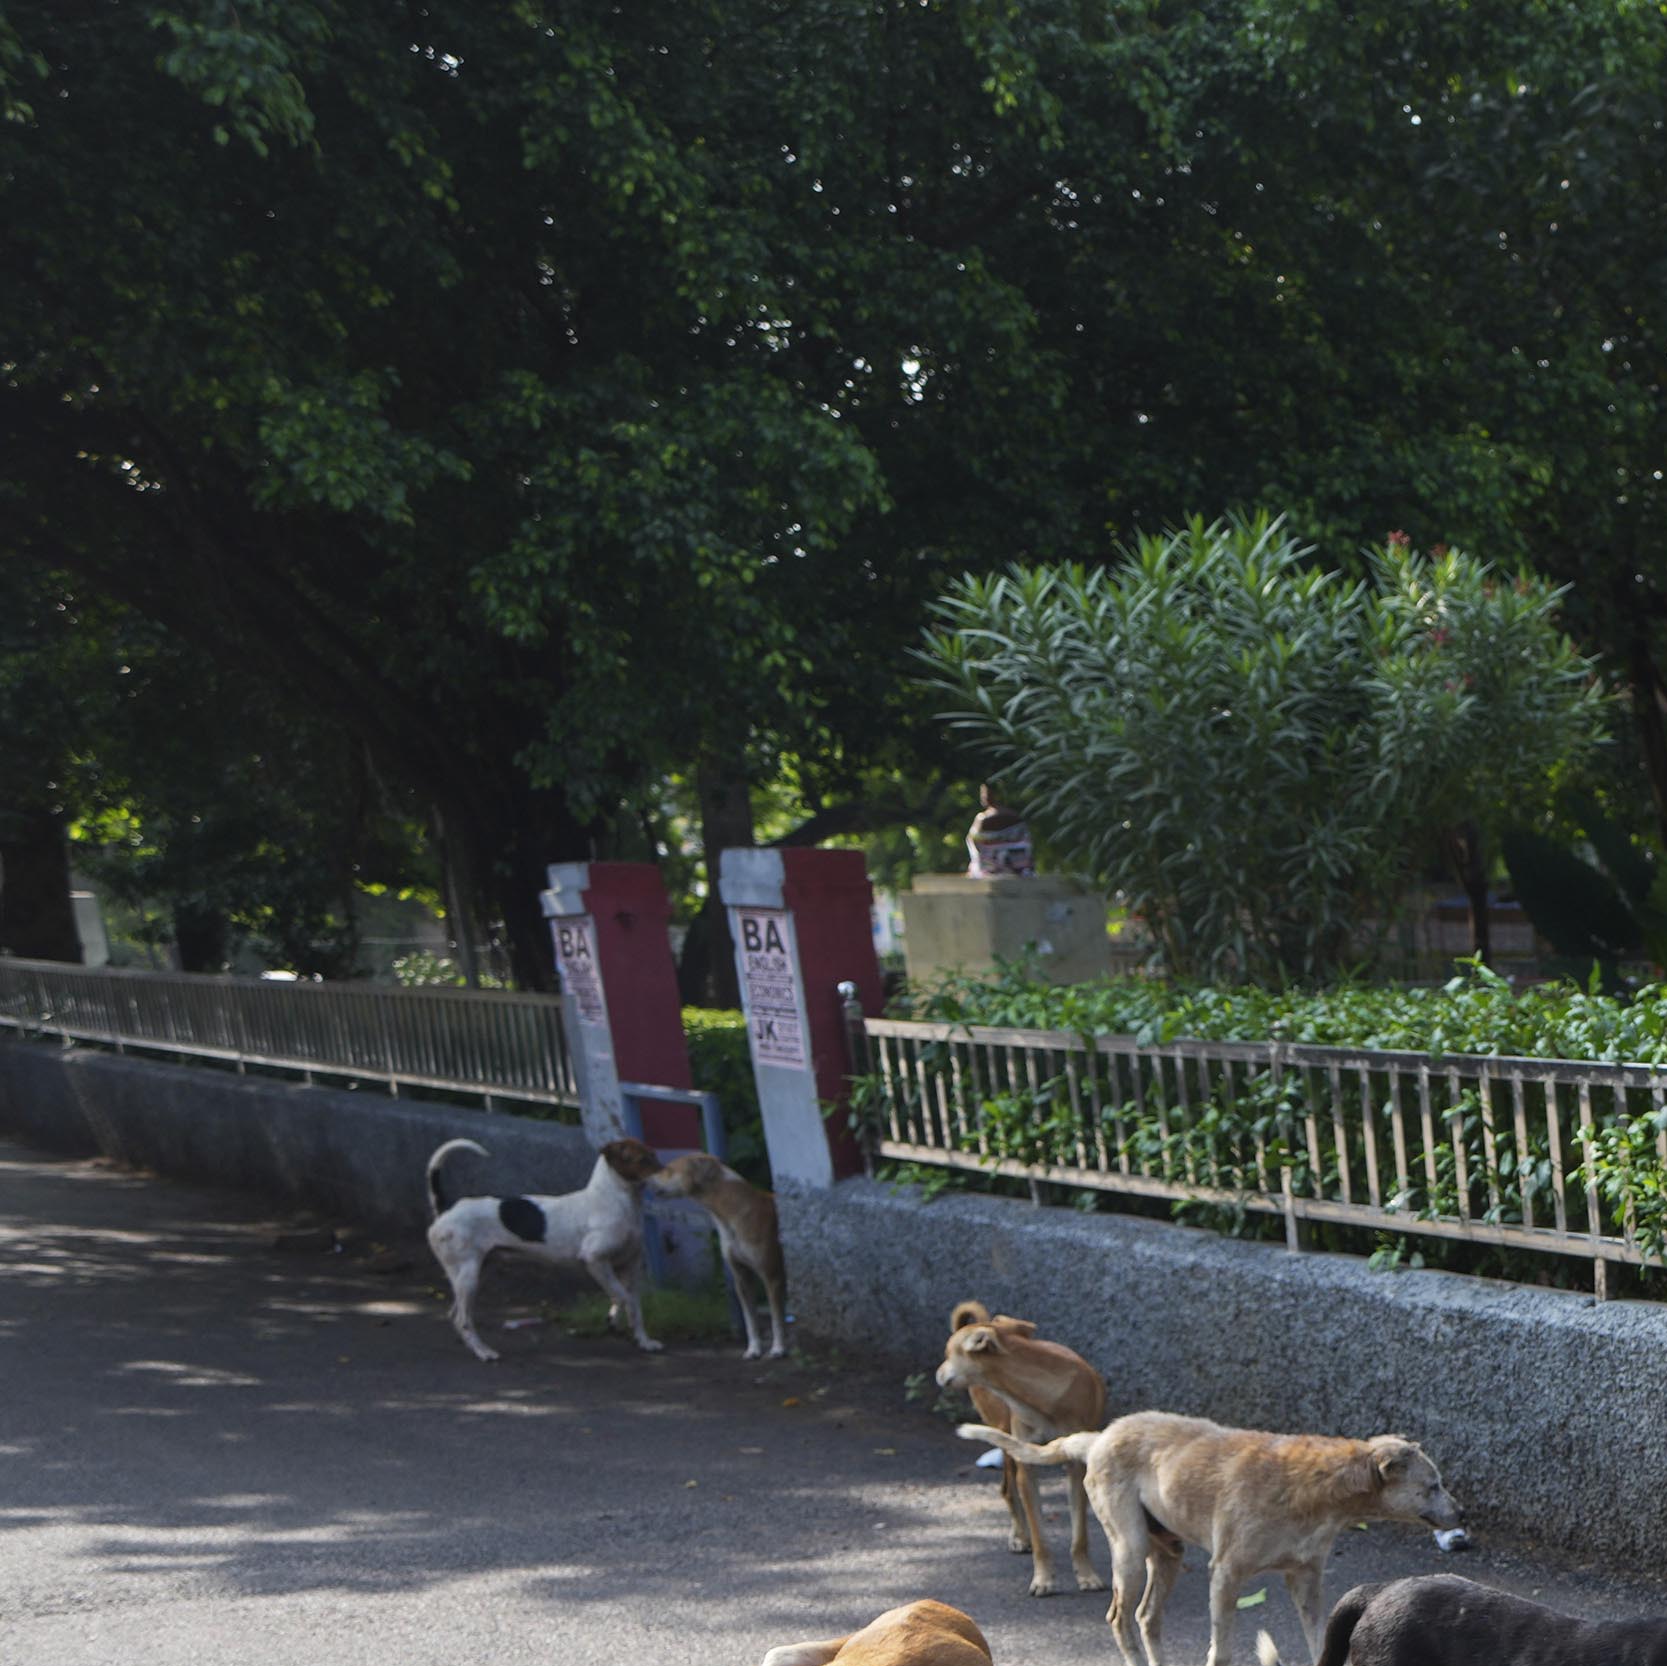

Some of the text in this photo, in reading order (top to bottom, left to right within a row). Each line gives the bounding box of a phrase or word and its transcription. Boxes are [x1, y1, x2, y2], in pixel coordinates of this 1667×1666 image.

[560, 928, 591, 959] BA
[742, 918, 786, 954] BA
[757, 1018, 778, 1042] JK
